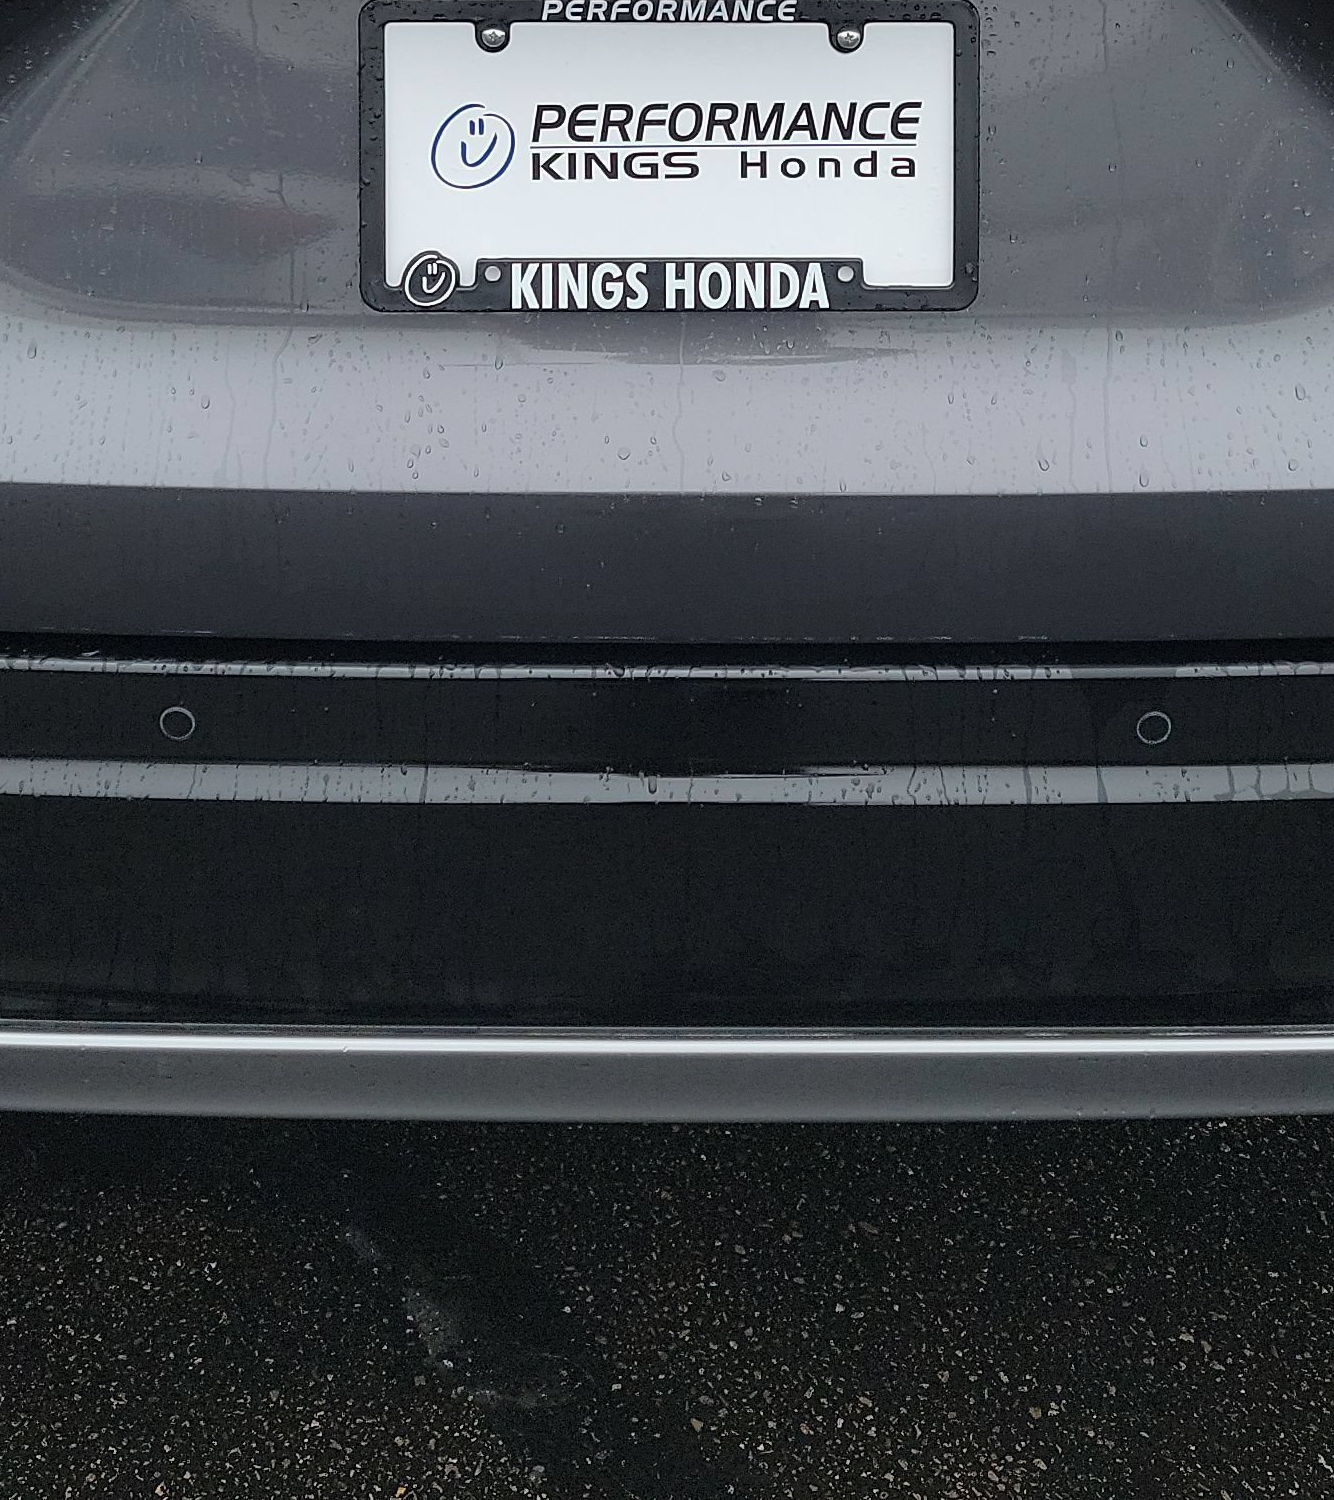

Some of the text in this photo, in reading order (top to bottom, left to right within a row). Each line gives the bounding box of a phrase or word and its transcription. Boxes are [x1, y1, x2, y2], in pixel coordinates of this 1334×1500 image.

[541, 0, 798, 21] PERFORMANCE
[531, 101, 922, 143] PERFORMANCE
[531, 150, 917, 181] KINGS Honda
[511, 262, 830, 310] KINGS HONDA
